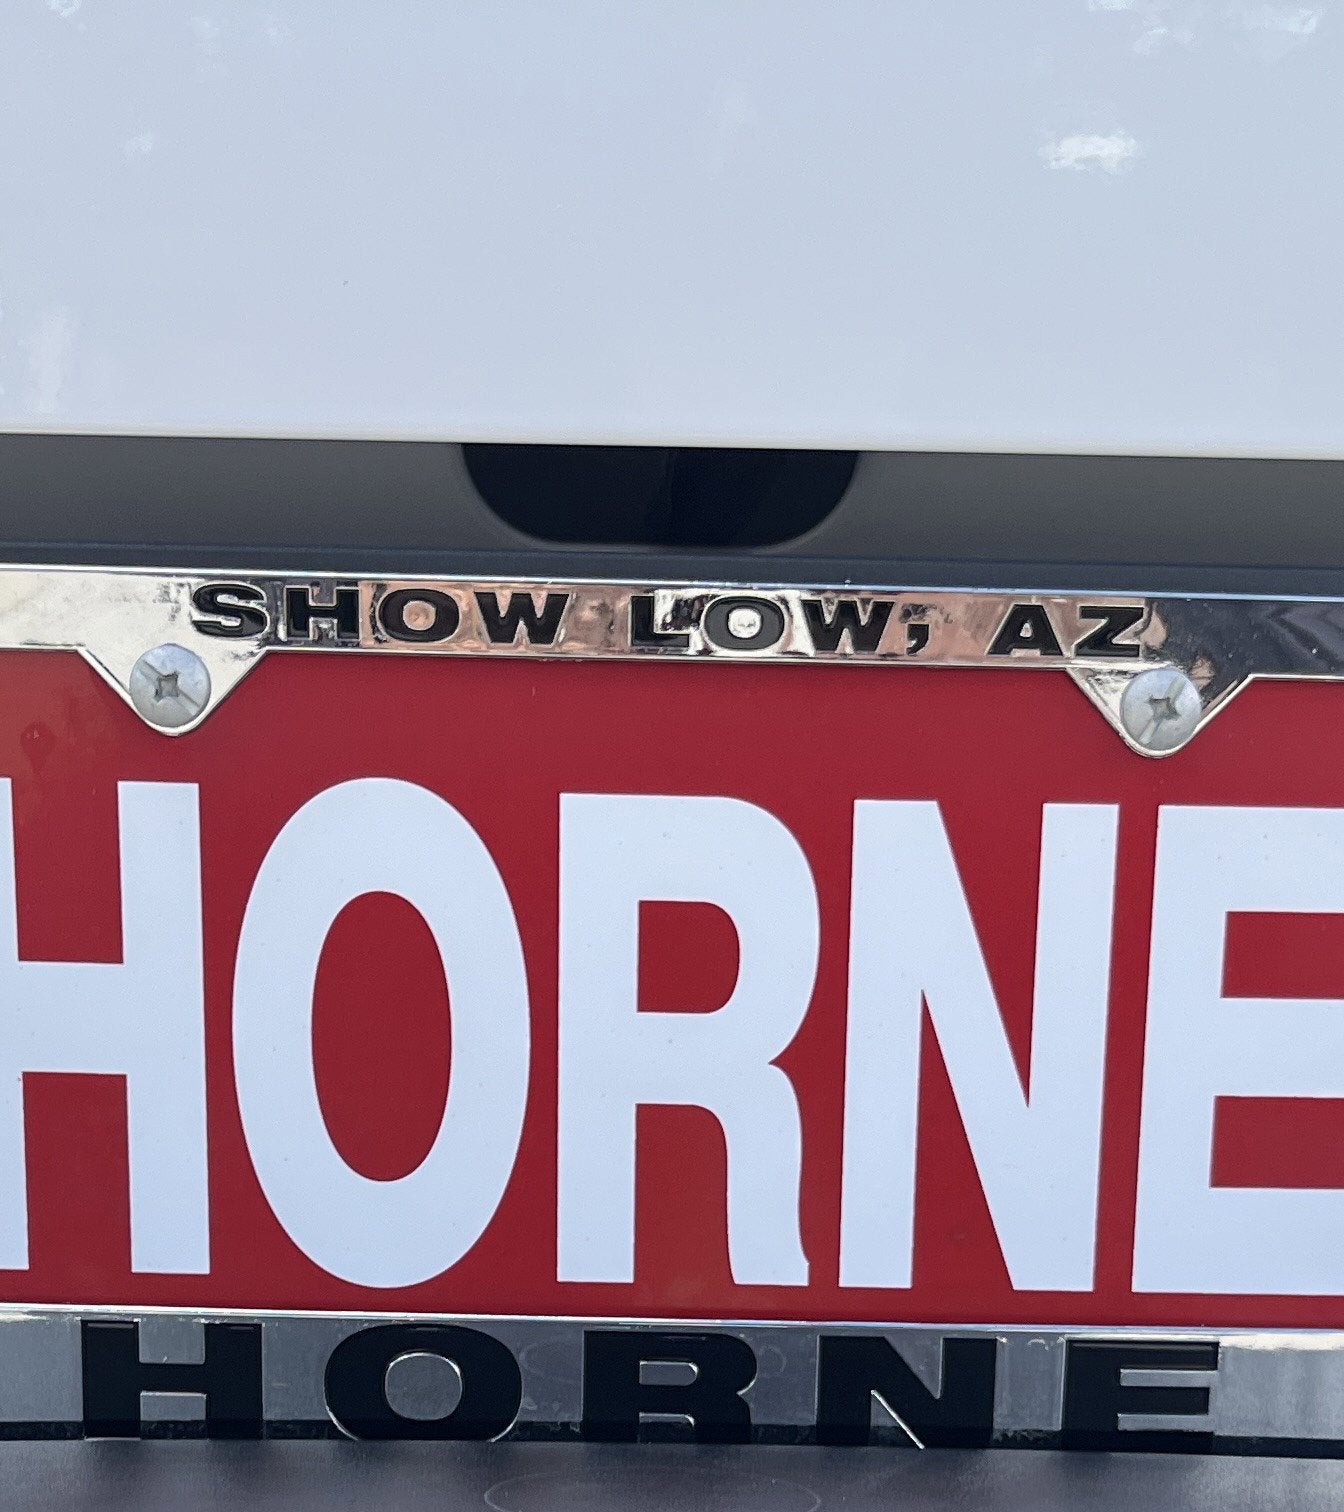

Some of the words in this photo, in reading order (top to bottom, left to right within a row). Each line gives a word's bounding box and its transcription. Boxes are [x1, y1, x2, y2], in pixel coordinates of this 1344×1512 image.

[191, 582, 574, 646] SHOW
[986, 603, 1145, 659] AZ
[80, 1319, 1221, 1453] HORNE
